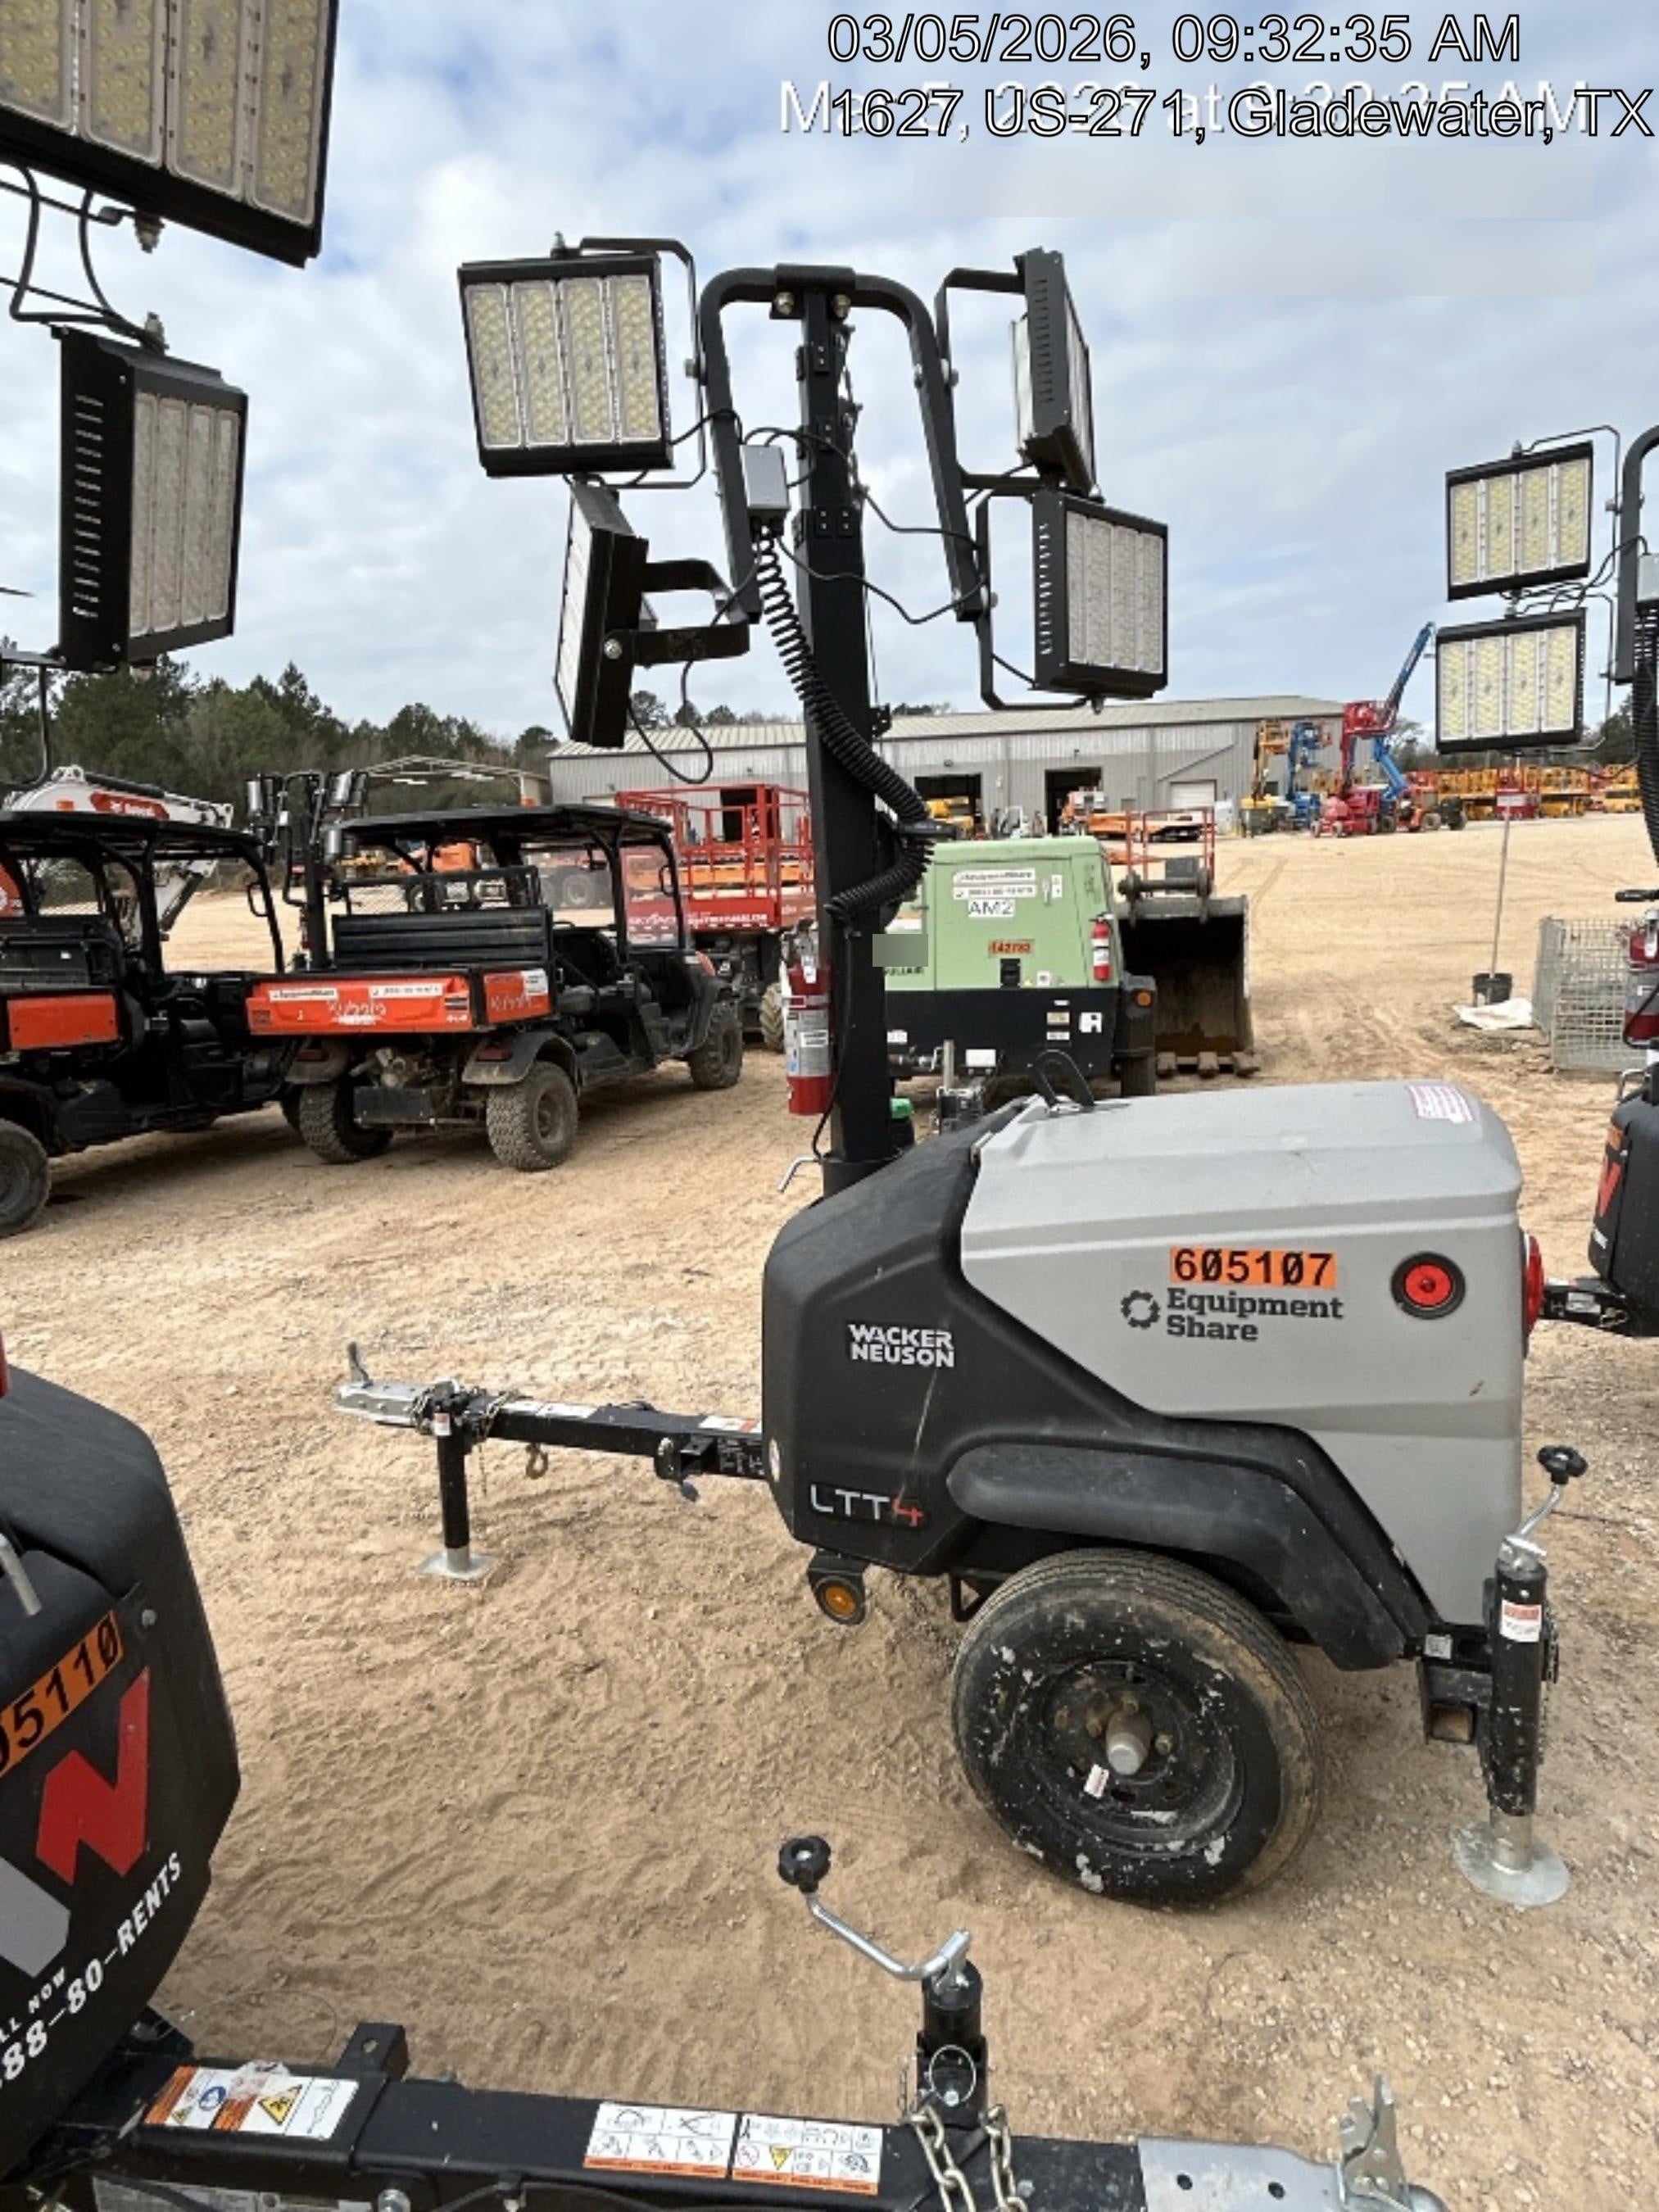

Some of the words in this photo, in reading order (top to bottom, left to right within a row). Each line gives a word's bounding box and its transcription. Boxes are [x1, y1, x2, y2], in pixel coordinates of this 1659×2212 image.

[1174, 1248, 1334, 1286] 605107
[1167, 1287, 1344, 1319] Equipment
[847, 1324, 954, 1350] WACKER
[1167, 1314, 1259, 1341] Share
[850, 1342, 955, 1367] NEUSON
[810, 1484, 924, 1527] LTT4
[0, 1852, 180, 2089] 88-80-RENTS
[29, 1967, 66, 2014] NOW
